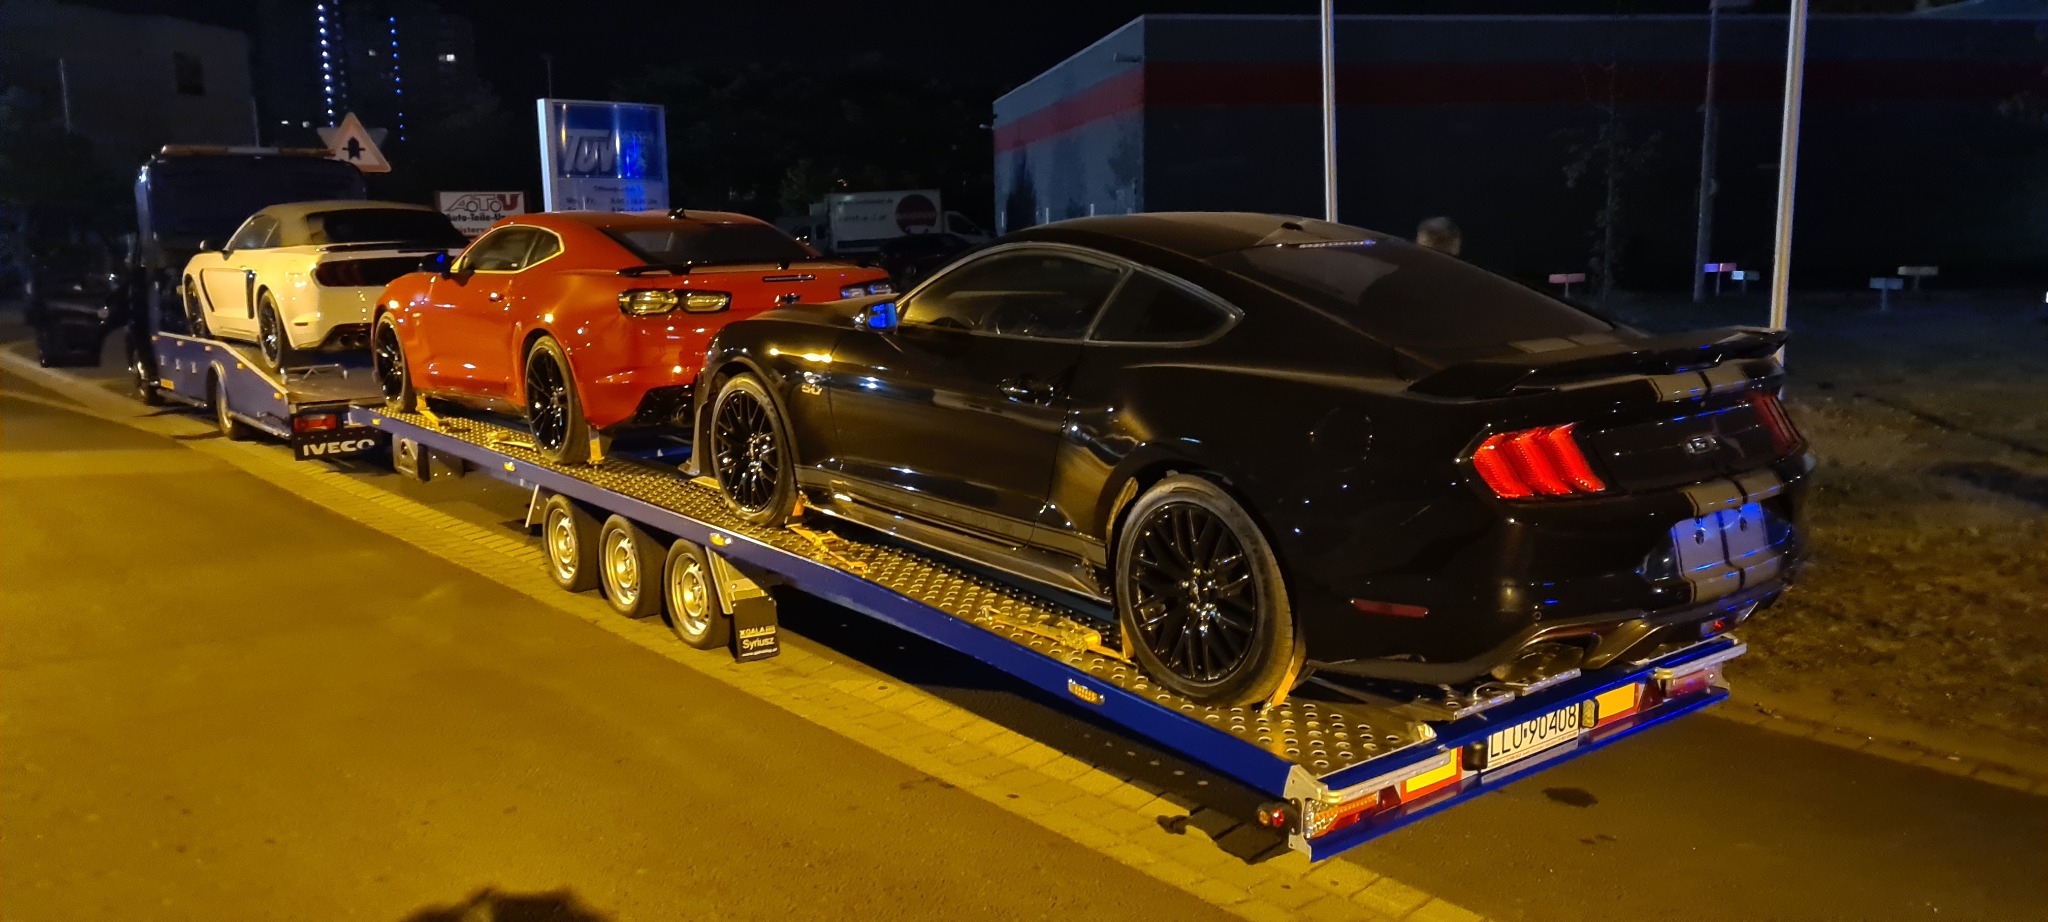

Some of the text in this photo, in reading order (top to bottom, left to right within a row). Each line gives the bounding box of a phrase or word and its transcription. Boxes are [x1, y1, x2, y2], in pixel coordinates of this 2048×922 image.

[303, 438, 375, 457] IVECO
[742, 637, 775, 650] Syriusz
[1490, 723, 1523, 758] LLU
[1529, 705, 1576, 744] 90408
